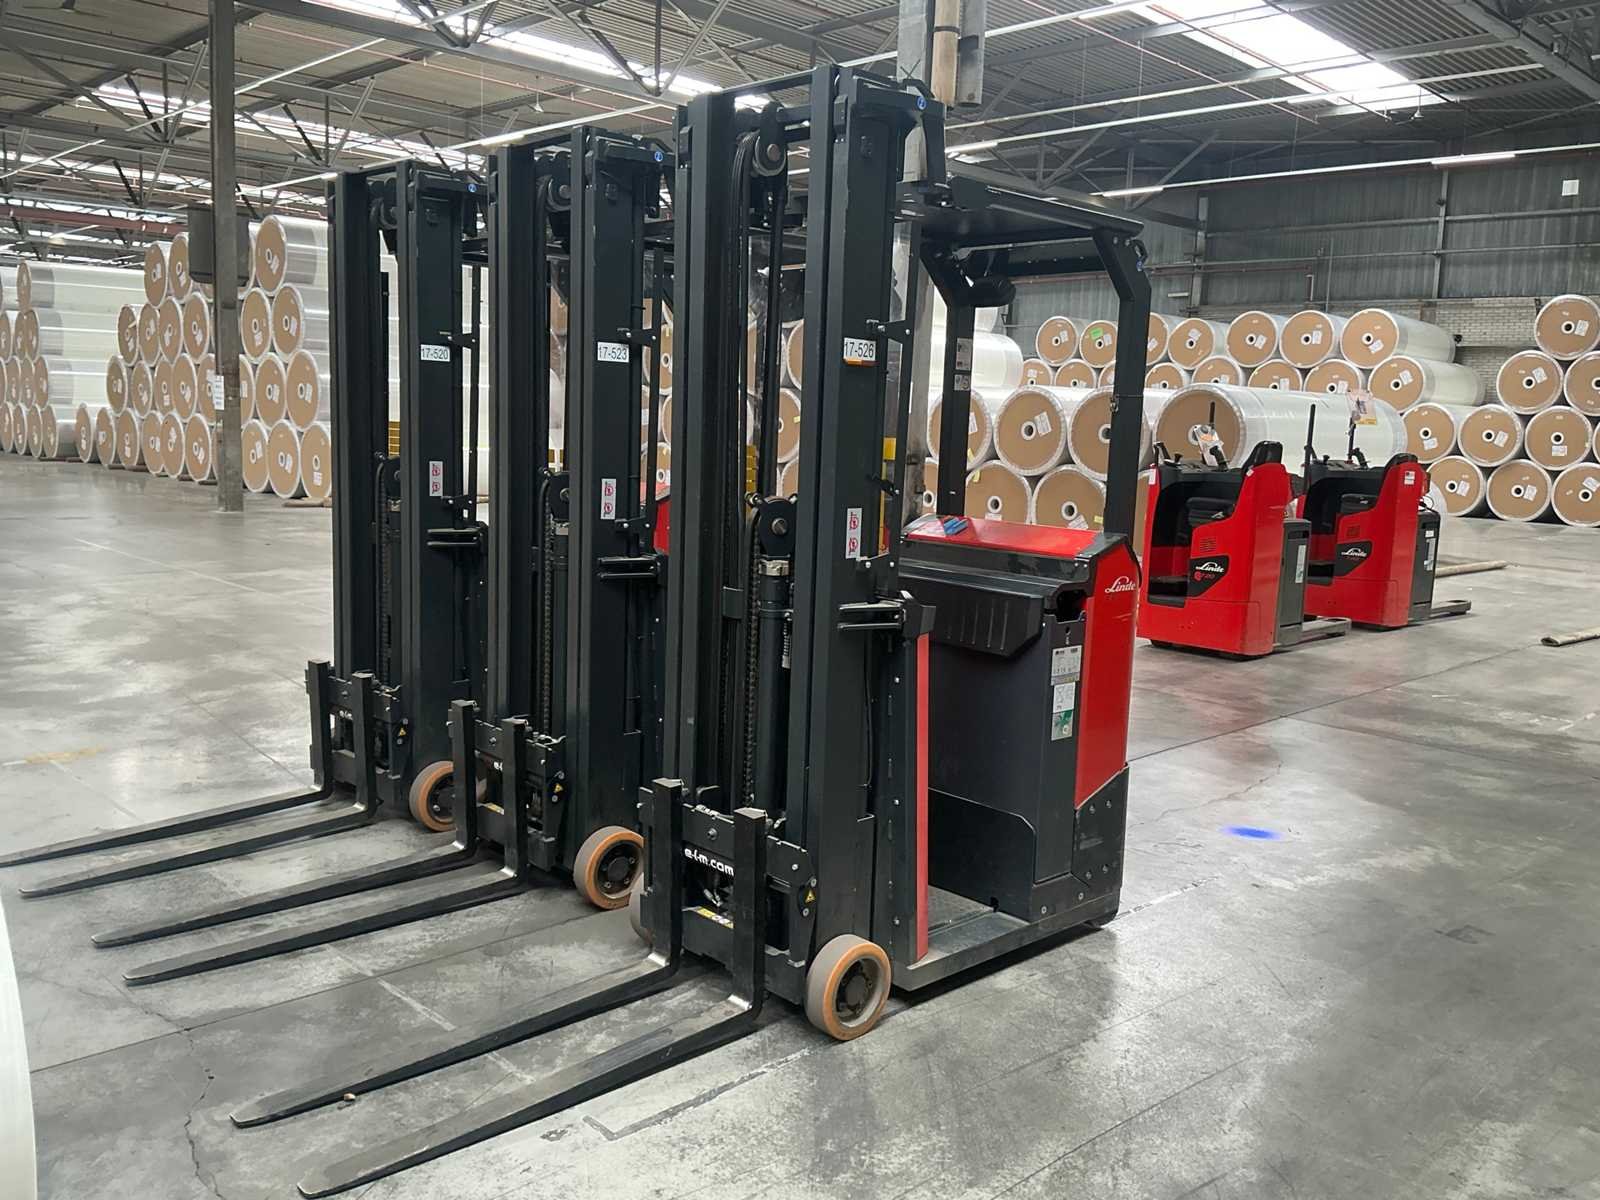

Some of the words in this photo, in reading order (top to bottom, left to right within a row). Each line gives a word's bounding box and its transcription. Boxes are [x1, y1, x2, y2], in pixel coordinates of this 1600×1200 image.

[421, 347, 449, 360] 17-520
[599, 346, 628, 361] 17-523
[845, 341, 874, 358] 17-526
[1195, 562, 1224, 573] Linde
[1104, 575, 1136, 593] Linde
